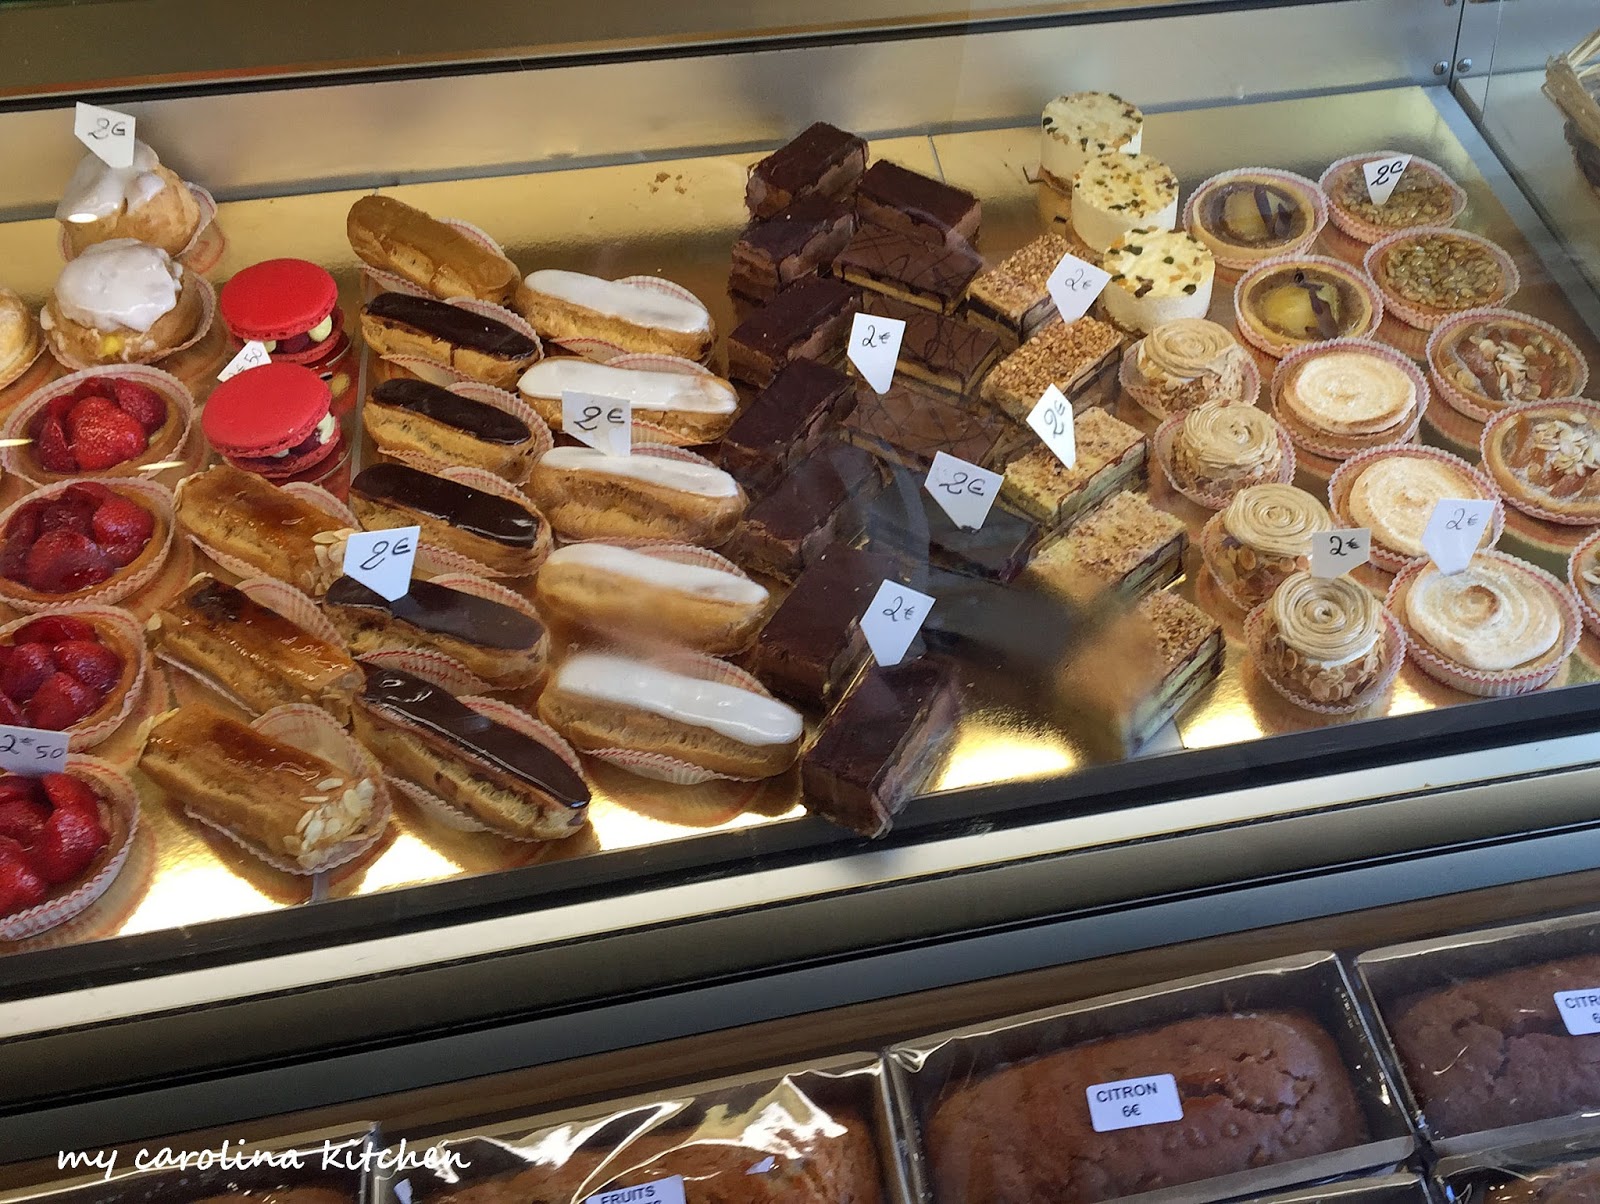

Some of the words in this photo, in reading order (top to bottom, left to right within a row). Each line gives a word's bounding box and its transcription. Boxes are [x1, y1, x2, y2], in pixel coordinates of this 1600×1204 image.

[1065, 268, 1092, 292] 2€
[861, 324, 892, 348] 2€
[573, 406, 625, 431] 2€
[1043, 399, 1066, 439] 2€
[938, 471, 986, 496] 2€
[1446, 507, 1479, 530] 2€
[359, 537, 411, 571] 2€
[1329, 535, 1361, 557] 2€
[882, 595, 915, 622] 2€
[1096, 1082, 1159, 1103] CITRON
[1122, 1103, 1142, 1118] 6€
[600, 1185, 656, 1204] FRUITS
